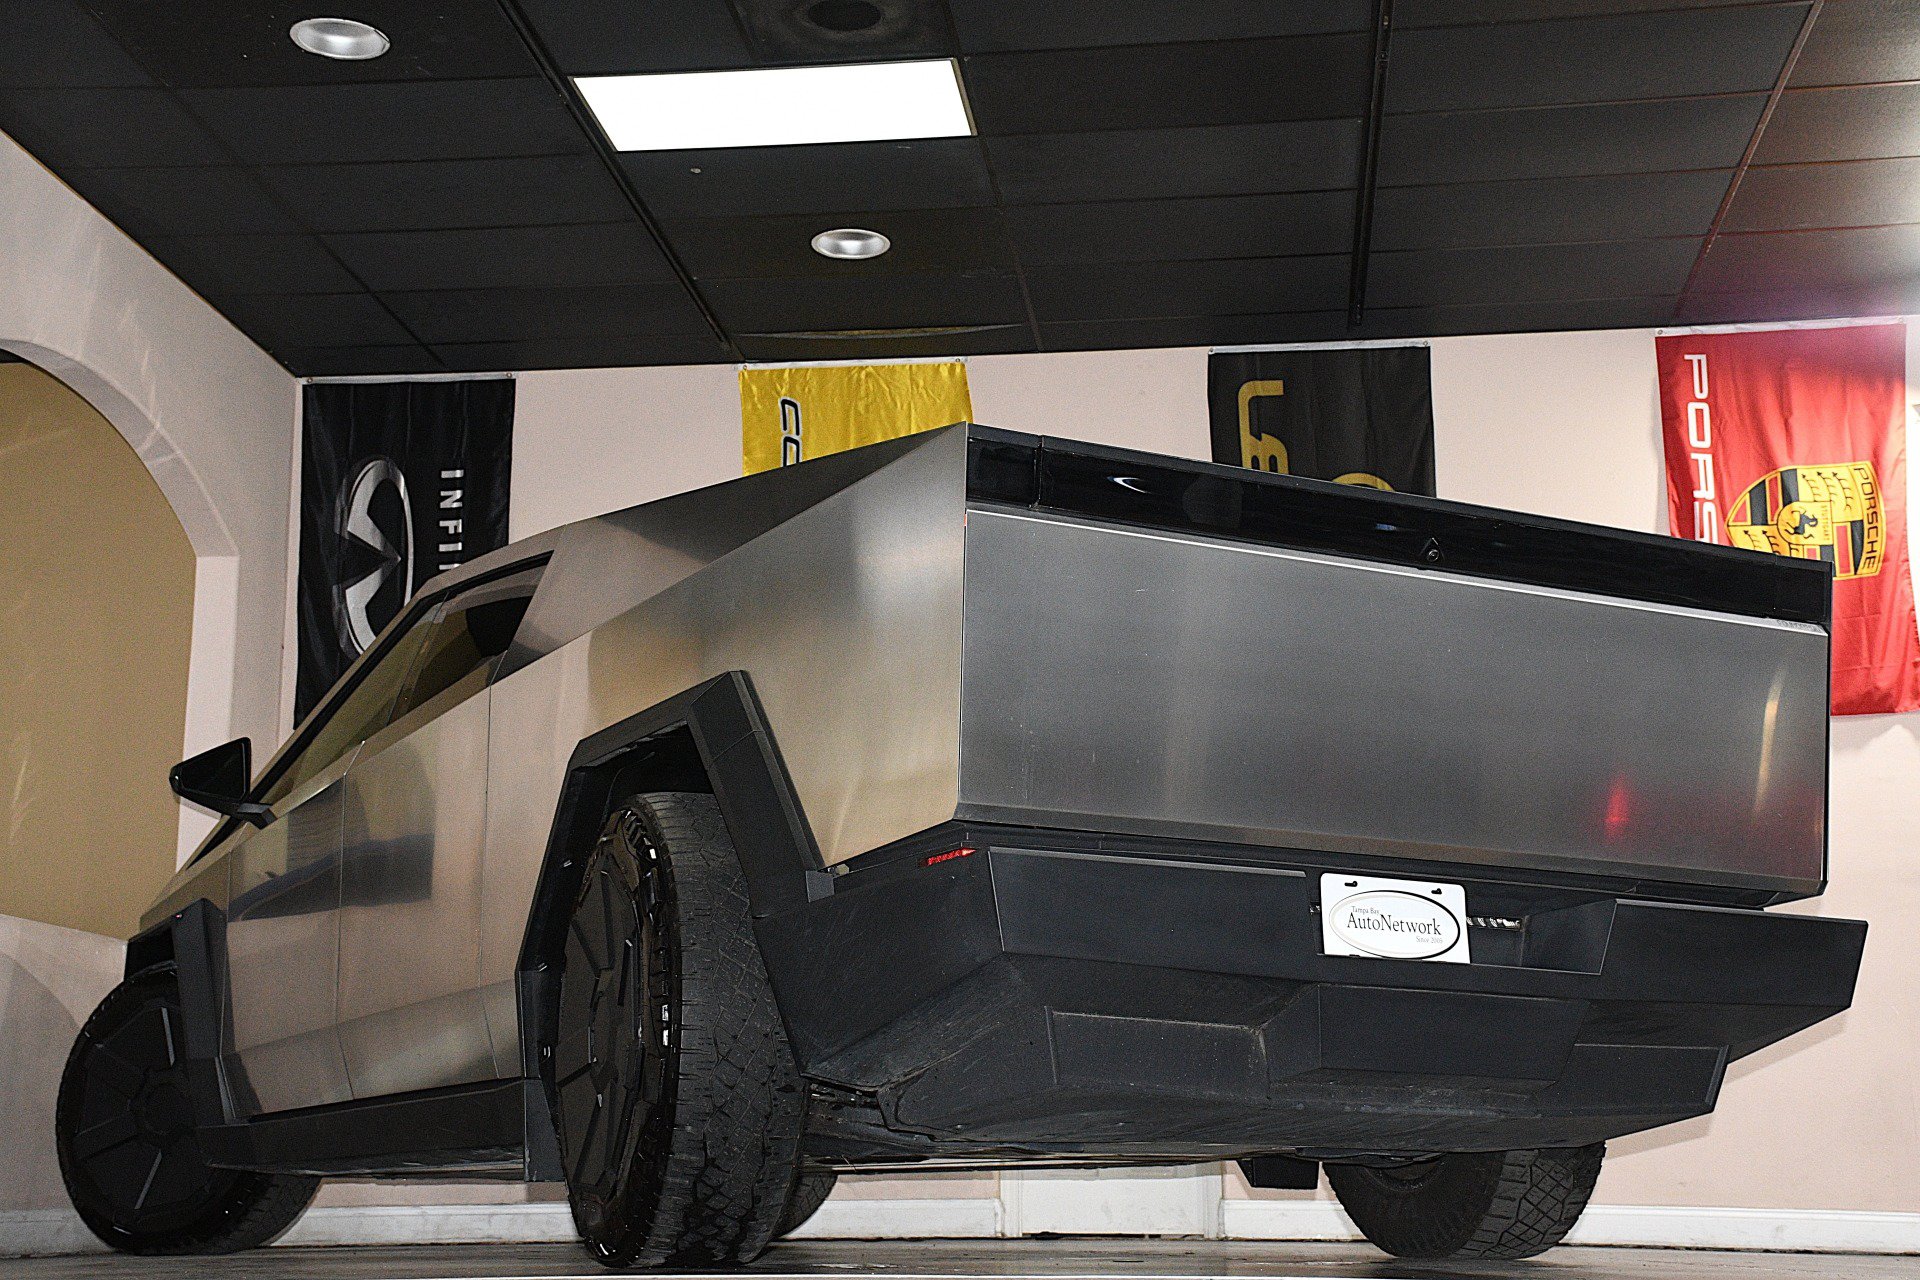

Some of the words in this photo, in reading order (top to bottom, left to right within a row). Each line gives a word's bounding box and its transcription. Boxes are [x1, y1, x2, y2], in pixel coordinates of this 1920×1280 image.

[1684, 353, 1719, 545] PORS
[438, 468, 465, 571] INFI
[1853, 467, 1880, 570] PORSCHE
[1347, 911, 1442, 936] AutoNetwork
[1351, 905, 1369, 916] Tampa
[1370, 907, 1380, 916] Bay
[1416, 935, 1430, 944] Since
